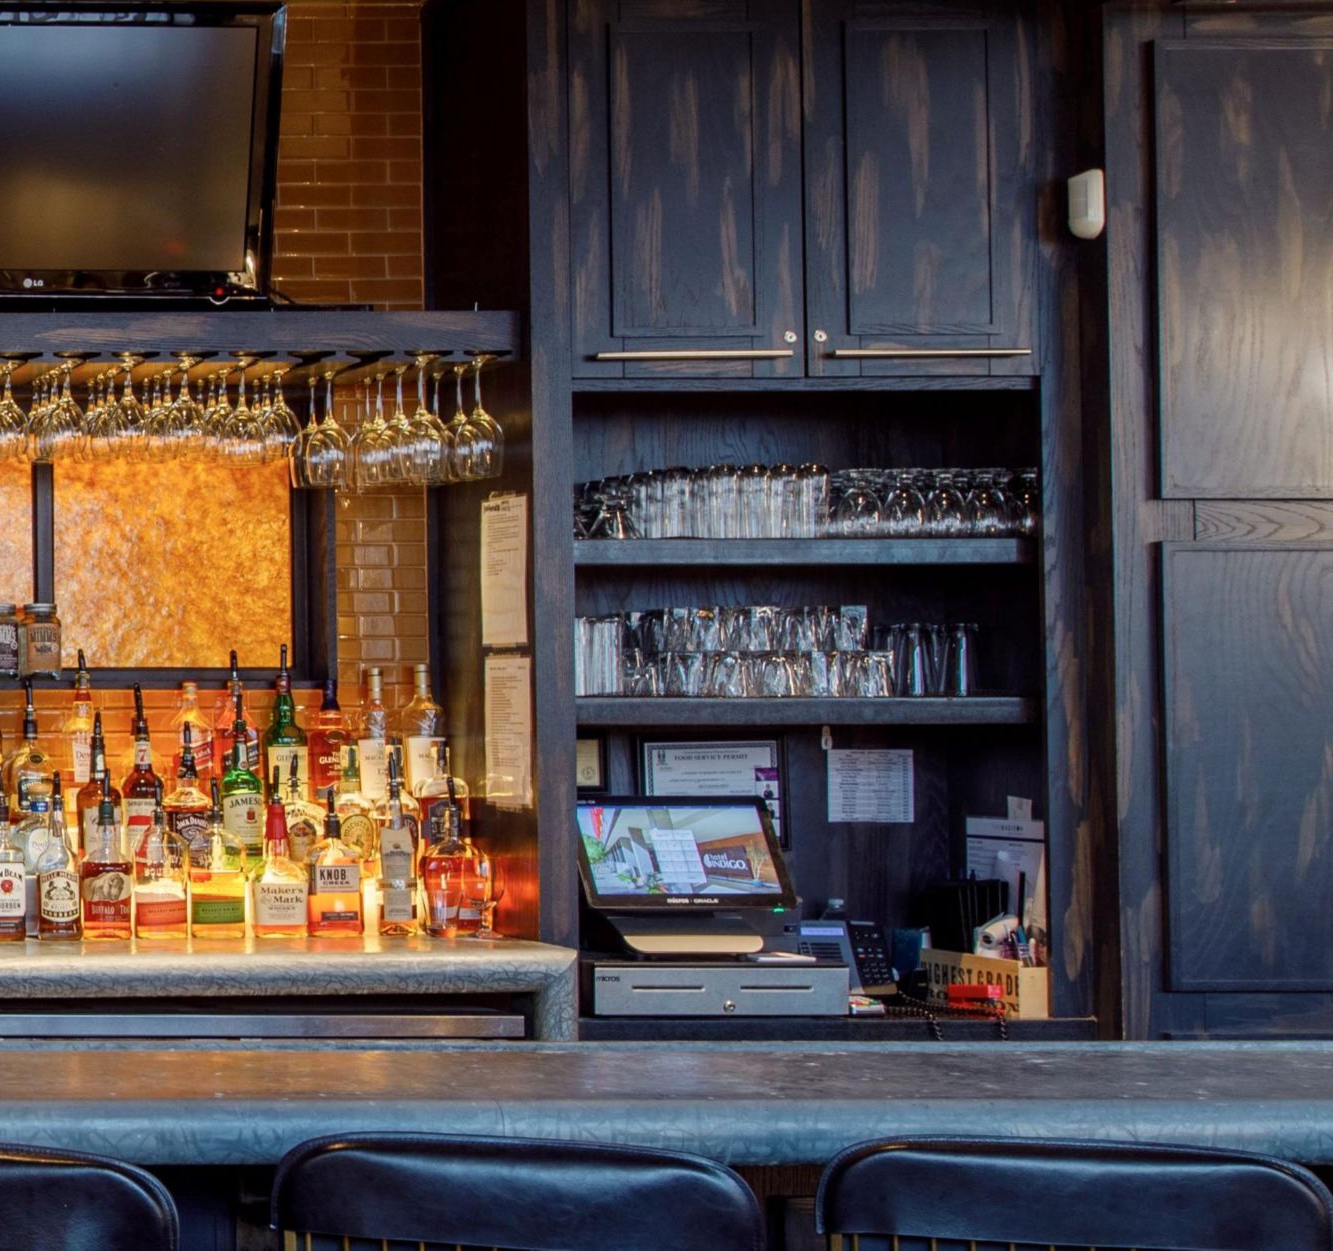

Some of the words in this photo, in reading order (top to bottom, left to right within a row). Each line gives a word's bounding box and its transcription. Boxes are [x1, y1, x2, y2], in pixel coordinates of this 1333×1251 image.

[138, 749, 146, 762] 7
[709, 852, 728, 860] hotel
[710, 859, 747, 870] INDIGO
[4, 868, 23, 882] BEAM
[319, 868, 347, 881] KNOB
[260, 886, 304, 895] Maker's
[273, 895, 304, 904] Mark
[596, 974, 620, 983] micros
